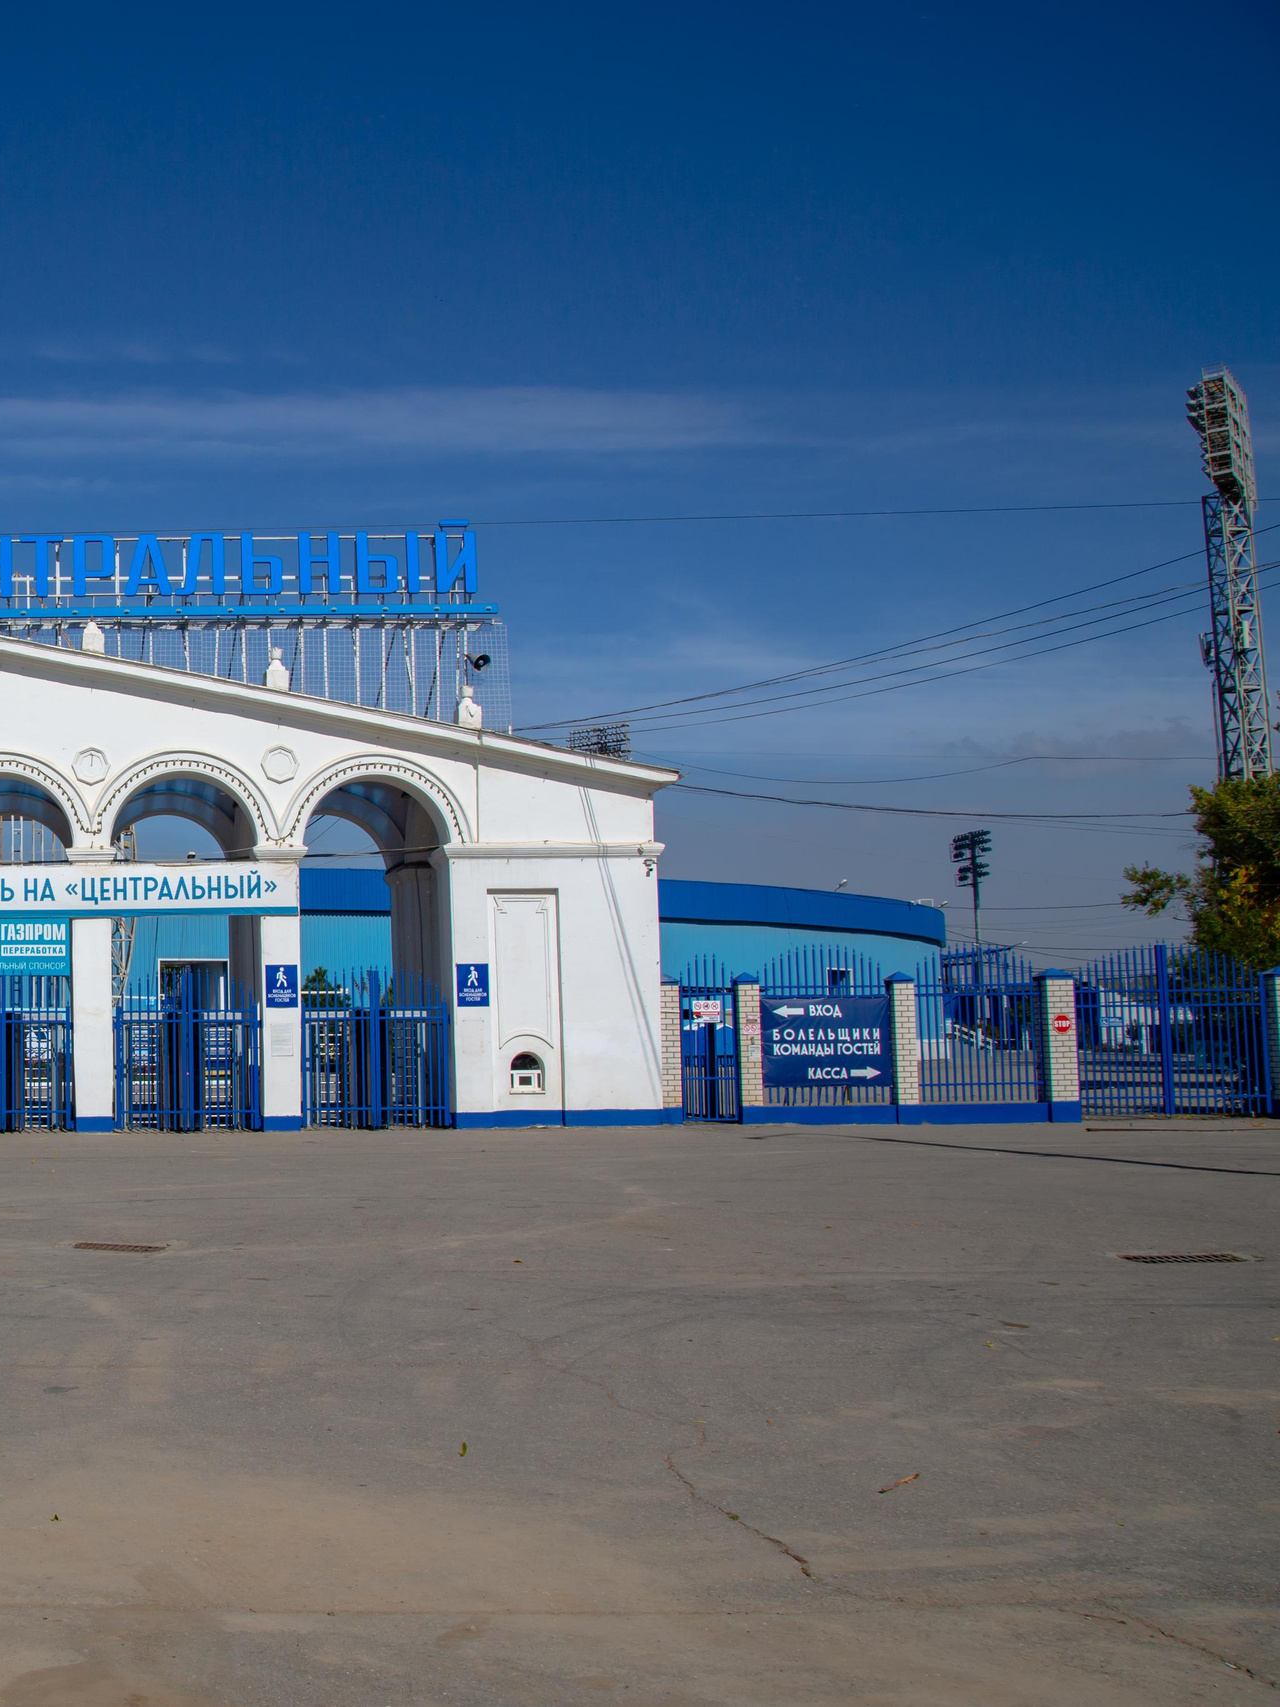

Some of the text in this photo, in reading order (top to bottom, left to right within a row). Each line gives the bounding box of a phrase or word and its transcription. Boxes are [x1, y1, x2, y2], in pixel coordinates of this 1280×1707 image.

[23, 877, 56, 902] НА
[65, 870, 278, 905] «ЦЕНТРАЛЬНЫЙ»
[1, 923, 66, 941] ГАЗПРОМ
[3, 946, 64, 955] ПЕРЕРАБОТКА
[28, 961, 66, 970] СПОНСОР
[808, 1004, 842, 1018] ВХОД
[1054, 1020, 1071, 1028] STOP
[772, 1028, 881, 1042] БОЛЕЛЬЩИКИ
[773, 1043, 834, 1057] КОМАНДЫ
[837, 1041, 881, 1055] ГОСТЕЙ
[808, 1067, 849, 1079] КАССА
